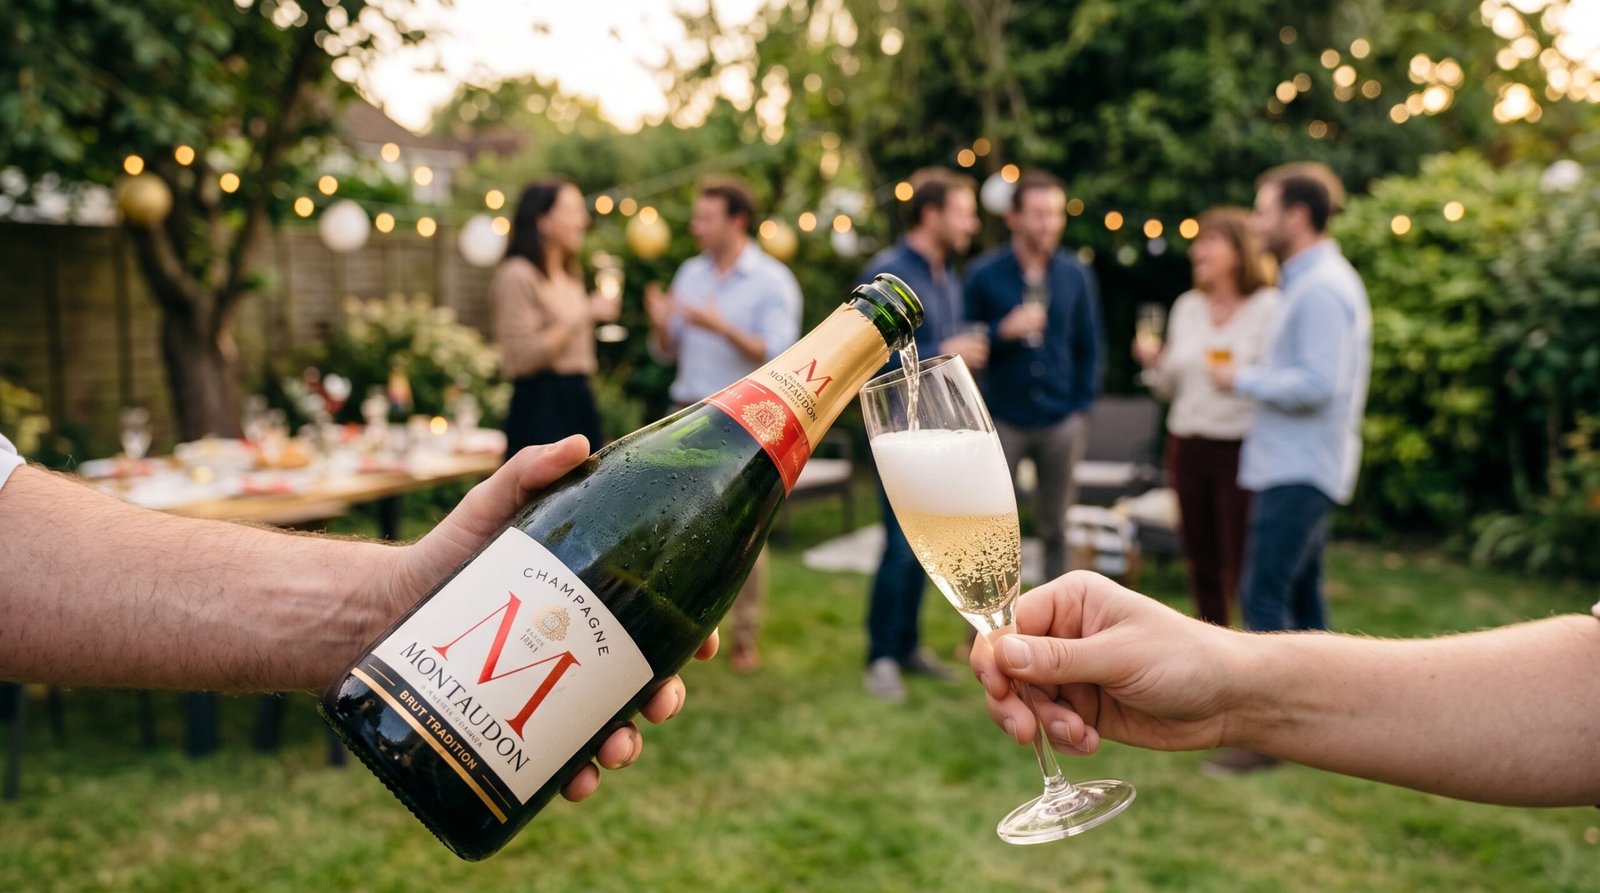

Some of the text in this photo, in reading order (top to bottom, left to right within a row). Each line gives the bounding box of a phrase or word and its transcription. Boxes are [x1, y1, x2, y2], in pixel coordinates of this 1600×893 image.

[767, 370, 818, 422] MONTAUDON
[793, 358, 833, 398] M
[523, 567, 610, 656] CHAMPAGNE
[400, 641, 530, 773] MONTAUDON
[432, 591, 581, 742] M
[399, 689, 427, 717] BRUT
[425, 716, 478, 770] TRADITION
